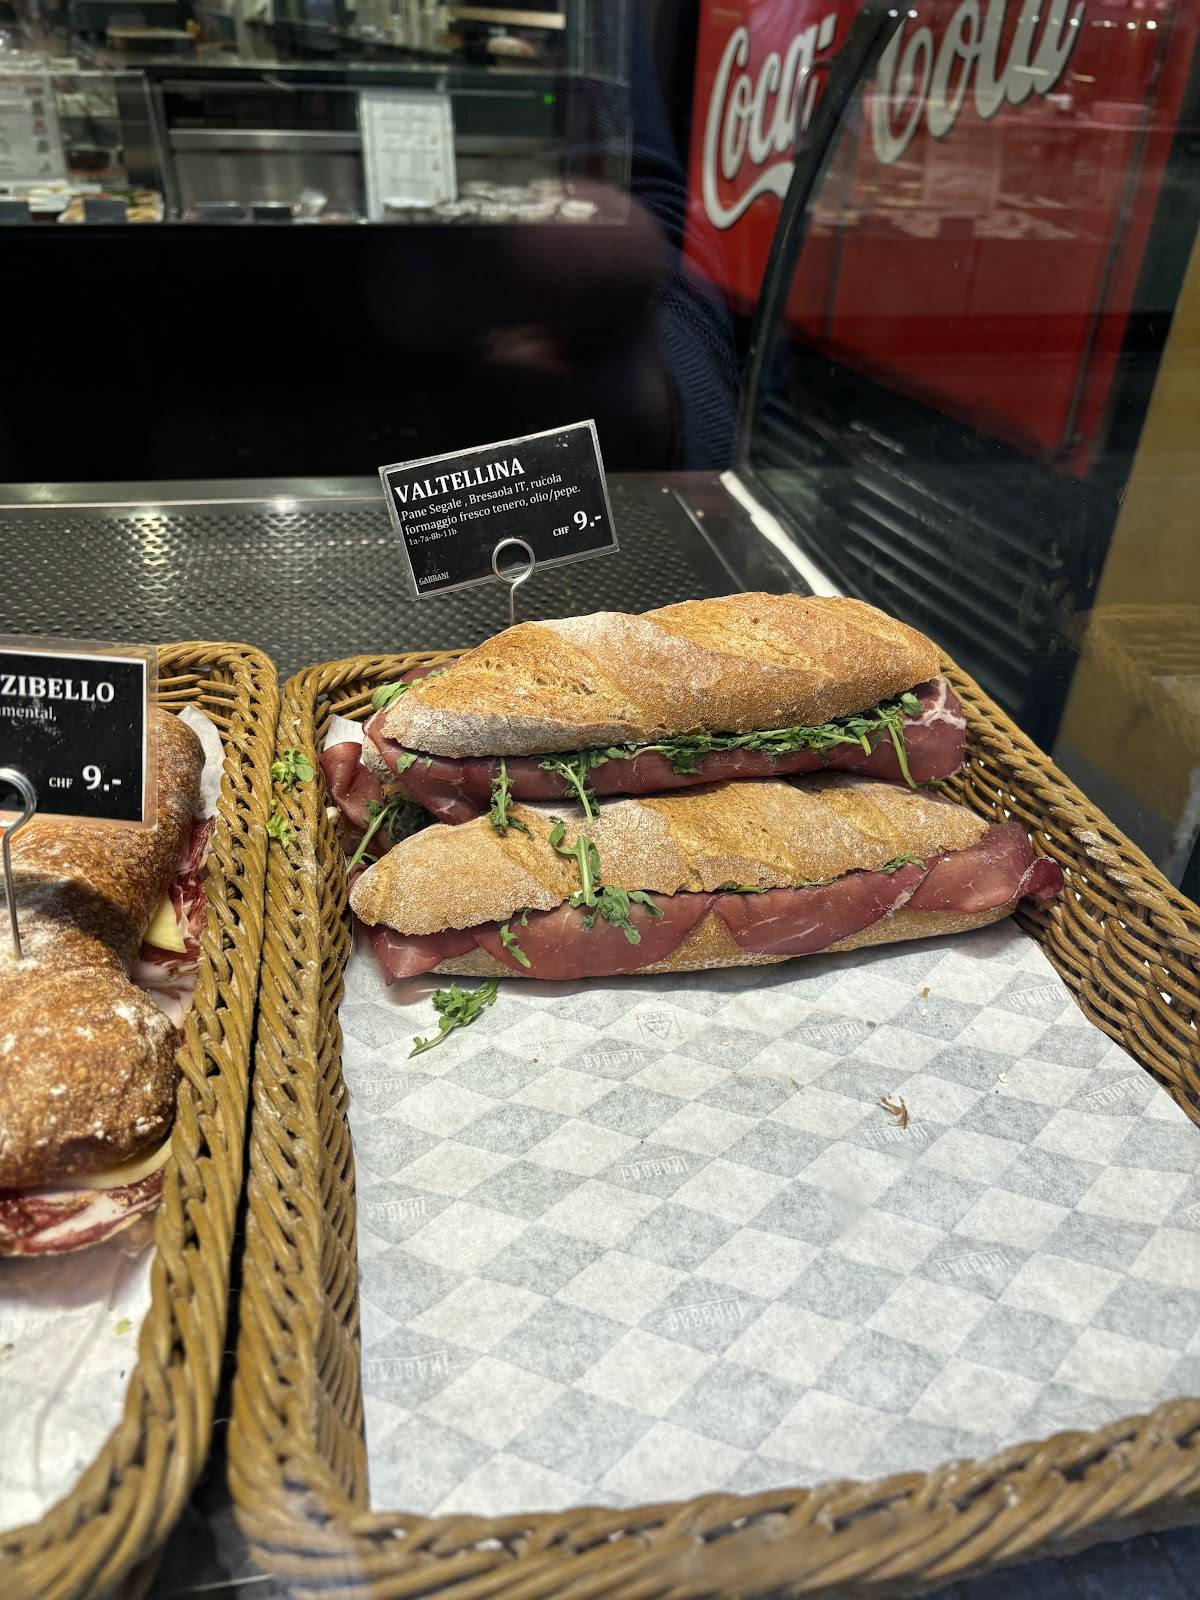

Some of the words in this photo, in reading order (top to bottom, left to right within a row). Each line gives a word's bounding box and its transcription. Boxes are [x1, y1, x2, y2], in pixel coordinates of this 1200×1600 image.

[394, 457, 526, 503] VALTELLINA
[400, 508, 427, 521] Pane
[429, 498, 462, 514] Segale
[469, 485, 513, 505] Bresaola
[515, 481, 529, 493] IT,
[530, 473, 562, 489] rucola
[405, 516, 458, 536] formaggio
[459, 507, 491, 522] fresco
[492, 498, 529, 514] tenero,
[529, 484, 581, 504] olio/pepe.
[552, 525, 570, 537] CHF
[573, 510, 601, 531] 9.-
[0, 674, 115, 703] ZIBELLO
[0, 706, 57, 722] mental,
[49, 776, 73, 789] CHF
[82, 764, 122, 792] 9.-
